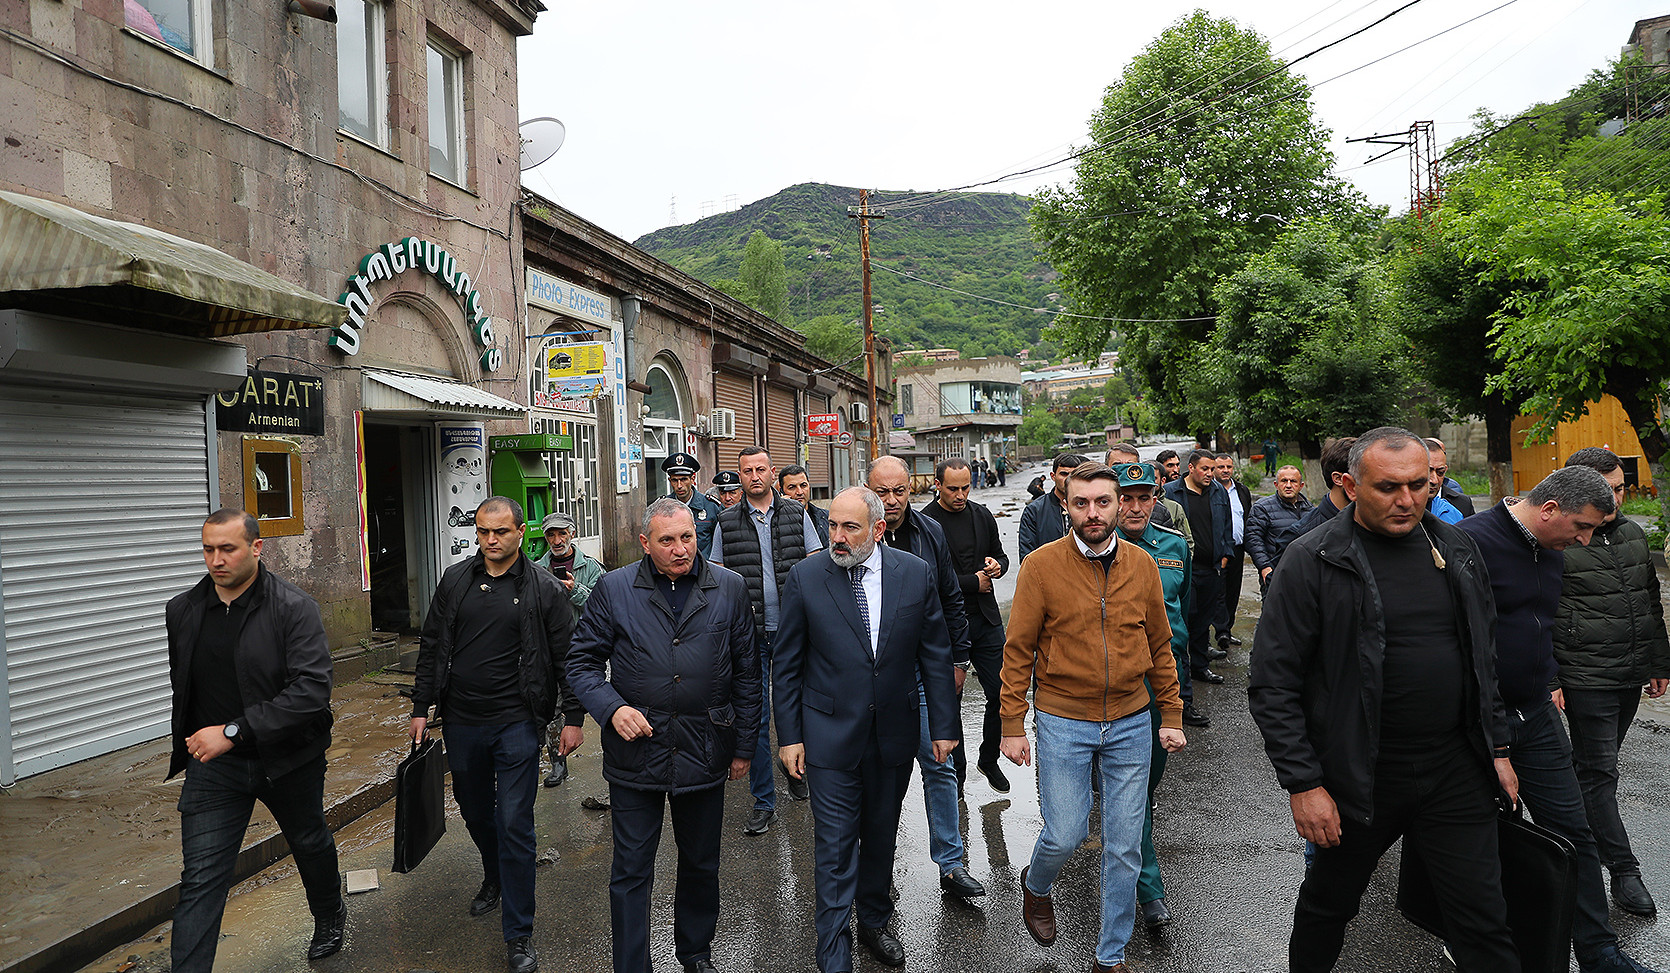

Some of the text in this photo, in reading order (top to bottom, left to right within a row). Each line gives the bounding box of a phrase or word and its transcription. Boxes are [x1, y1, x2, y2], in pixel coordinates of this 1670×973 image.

[532, 273, 605, 319] Photo Express
[248, 412, 300, 427] Armenian
